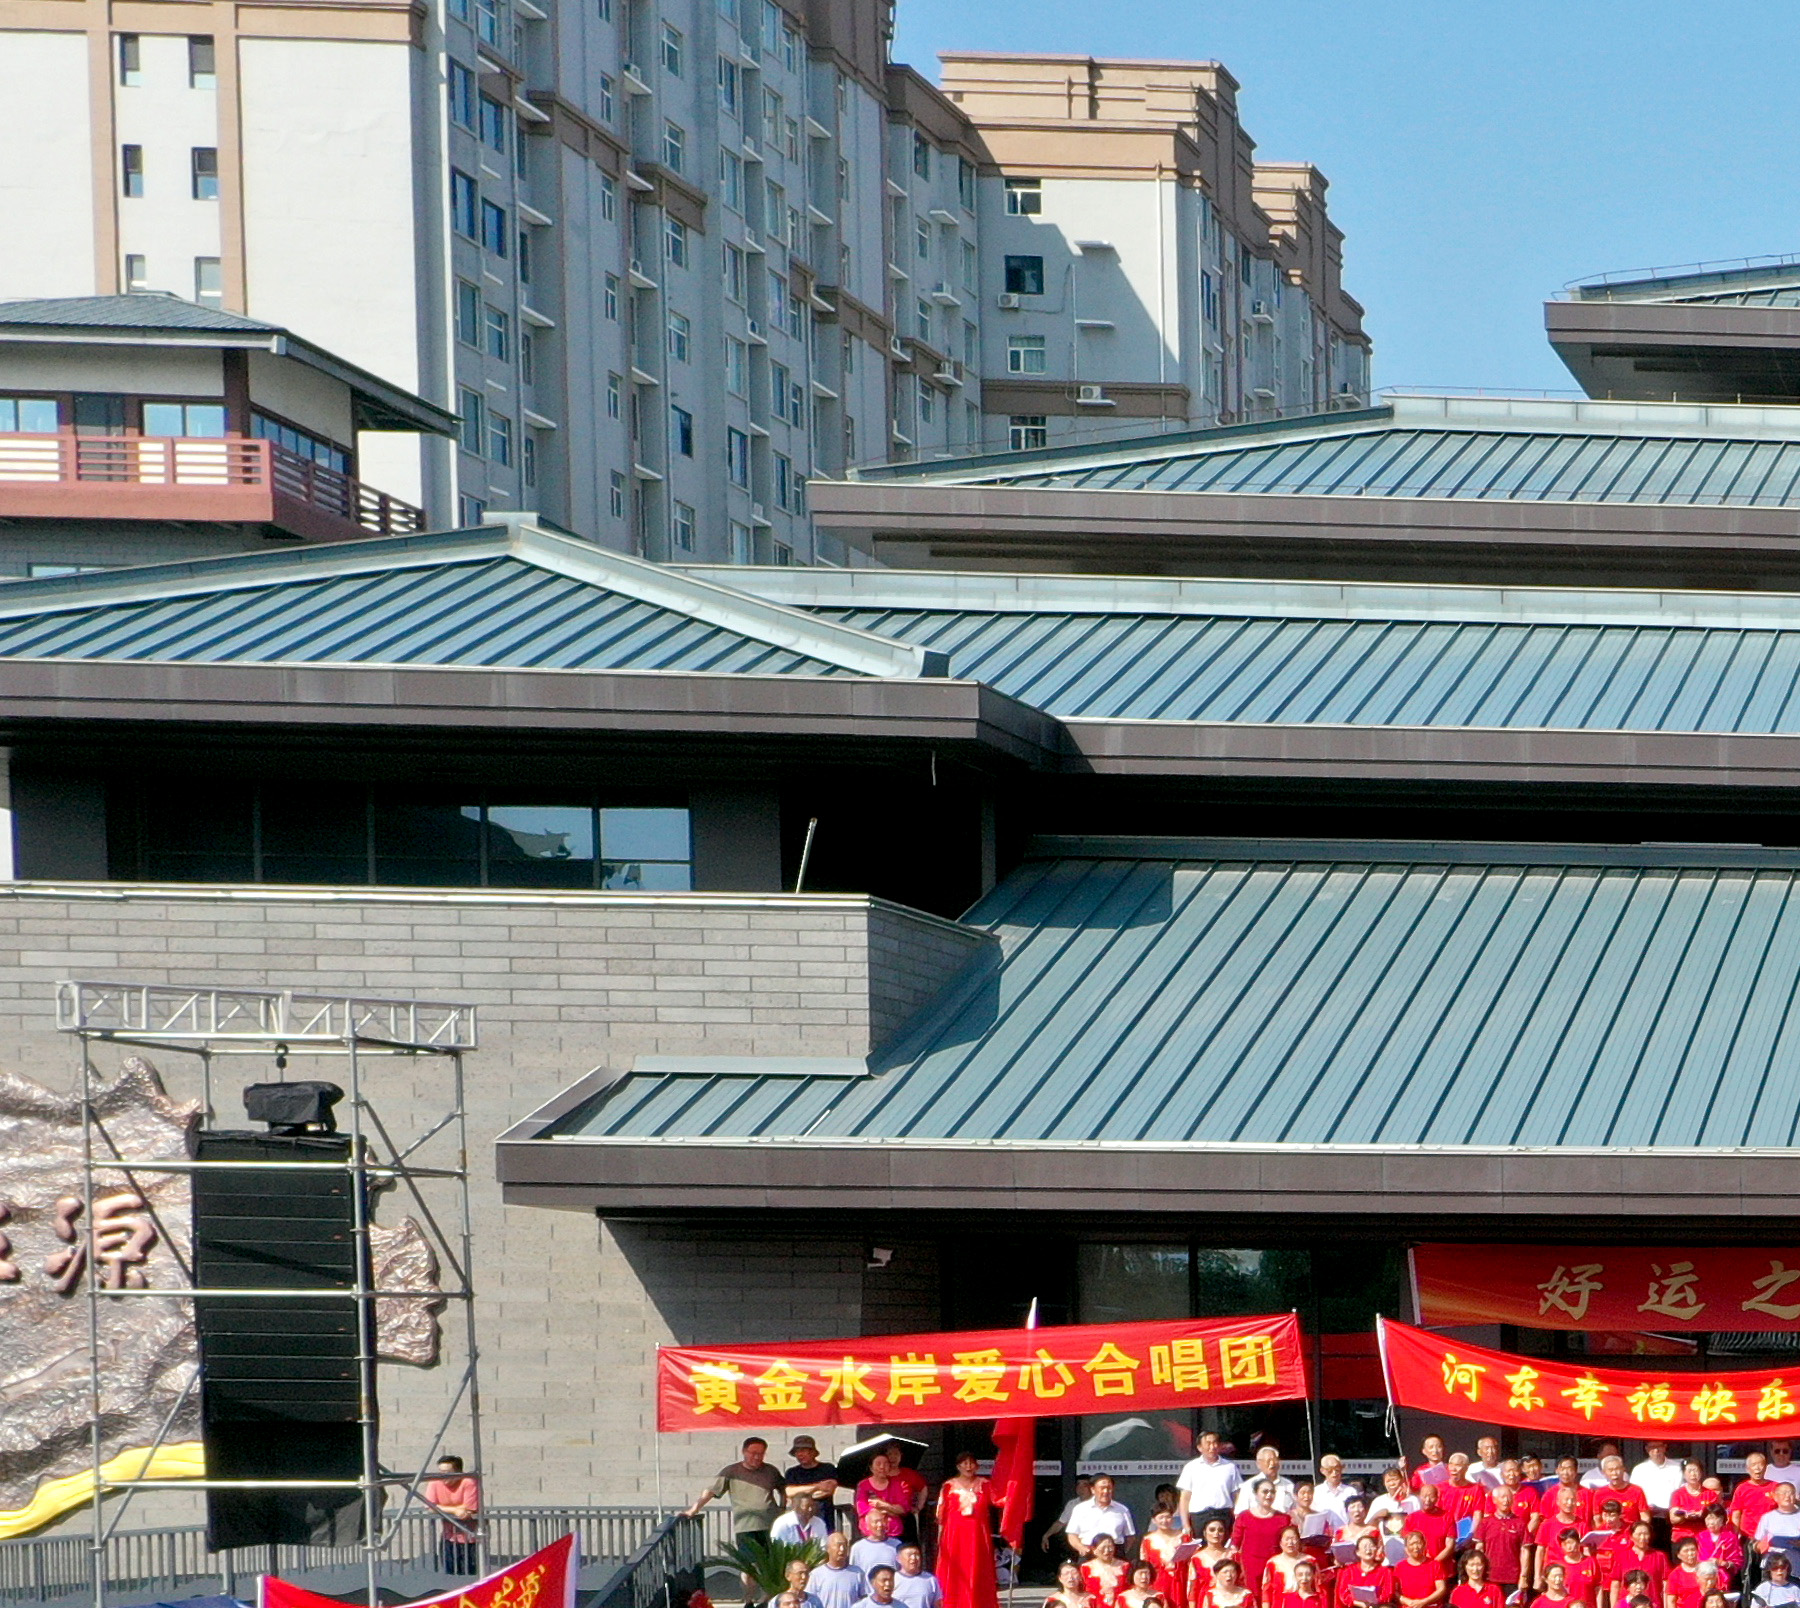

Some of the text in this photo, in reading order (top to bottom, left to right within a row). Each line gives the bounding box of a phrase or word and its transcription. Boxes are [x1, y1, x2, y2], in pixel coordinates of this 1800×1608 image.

[689, 1335, 1278, 1415] 黄金水岸爱心合唱团
